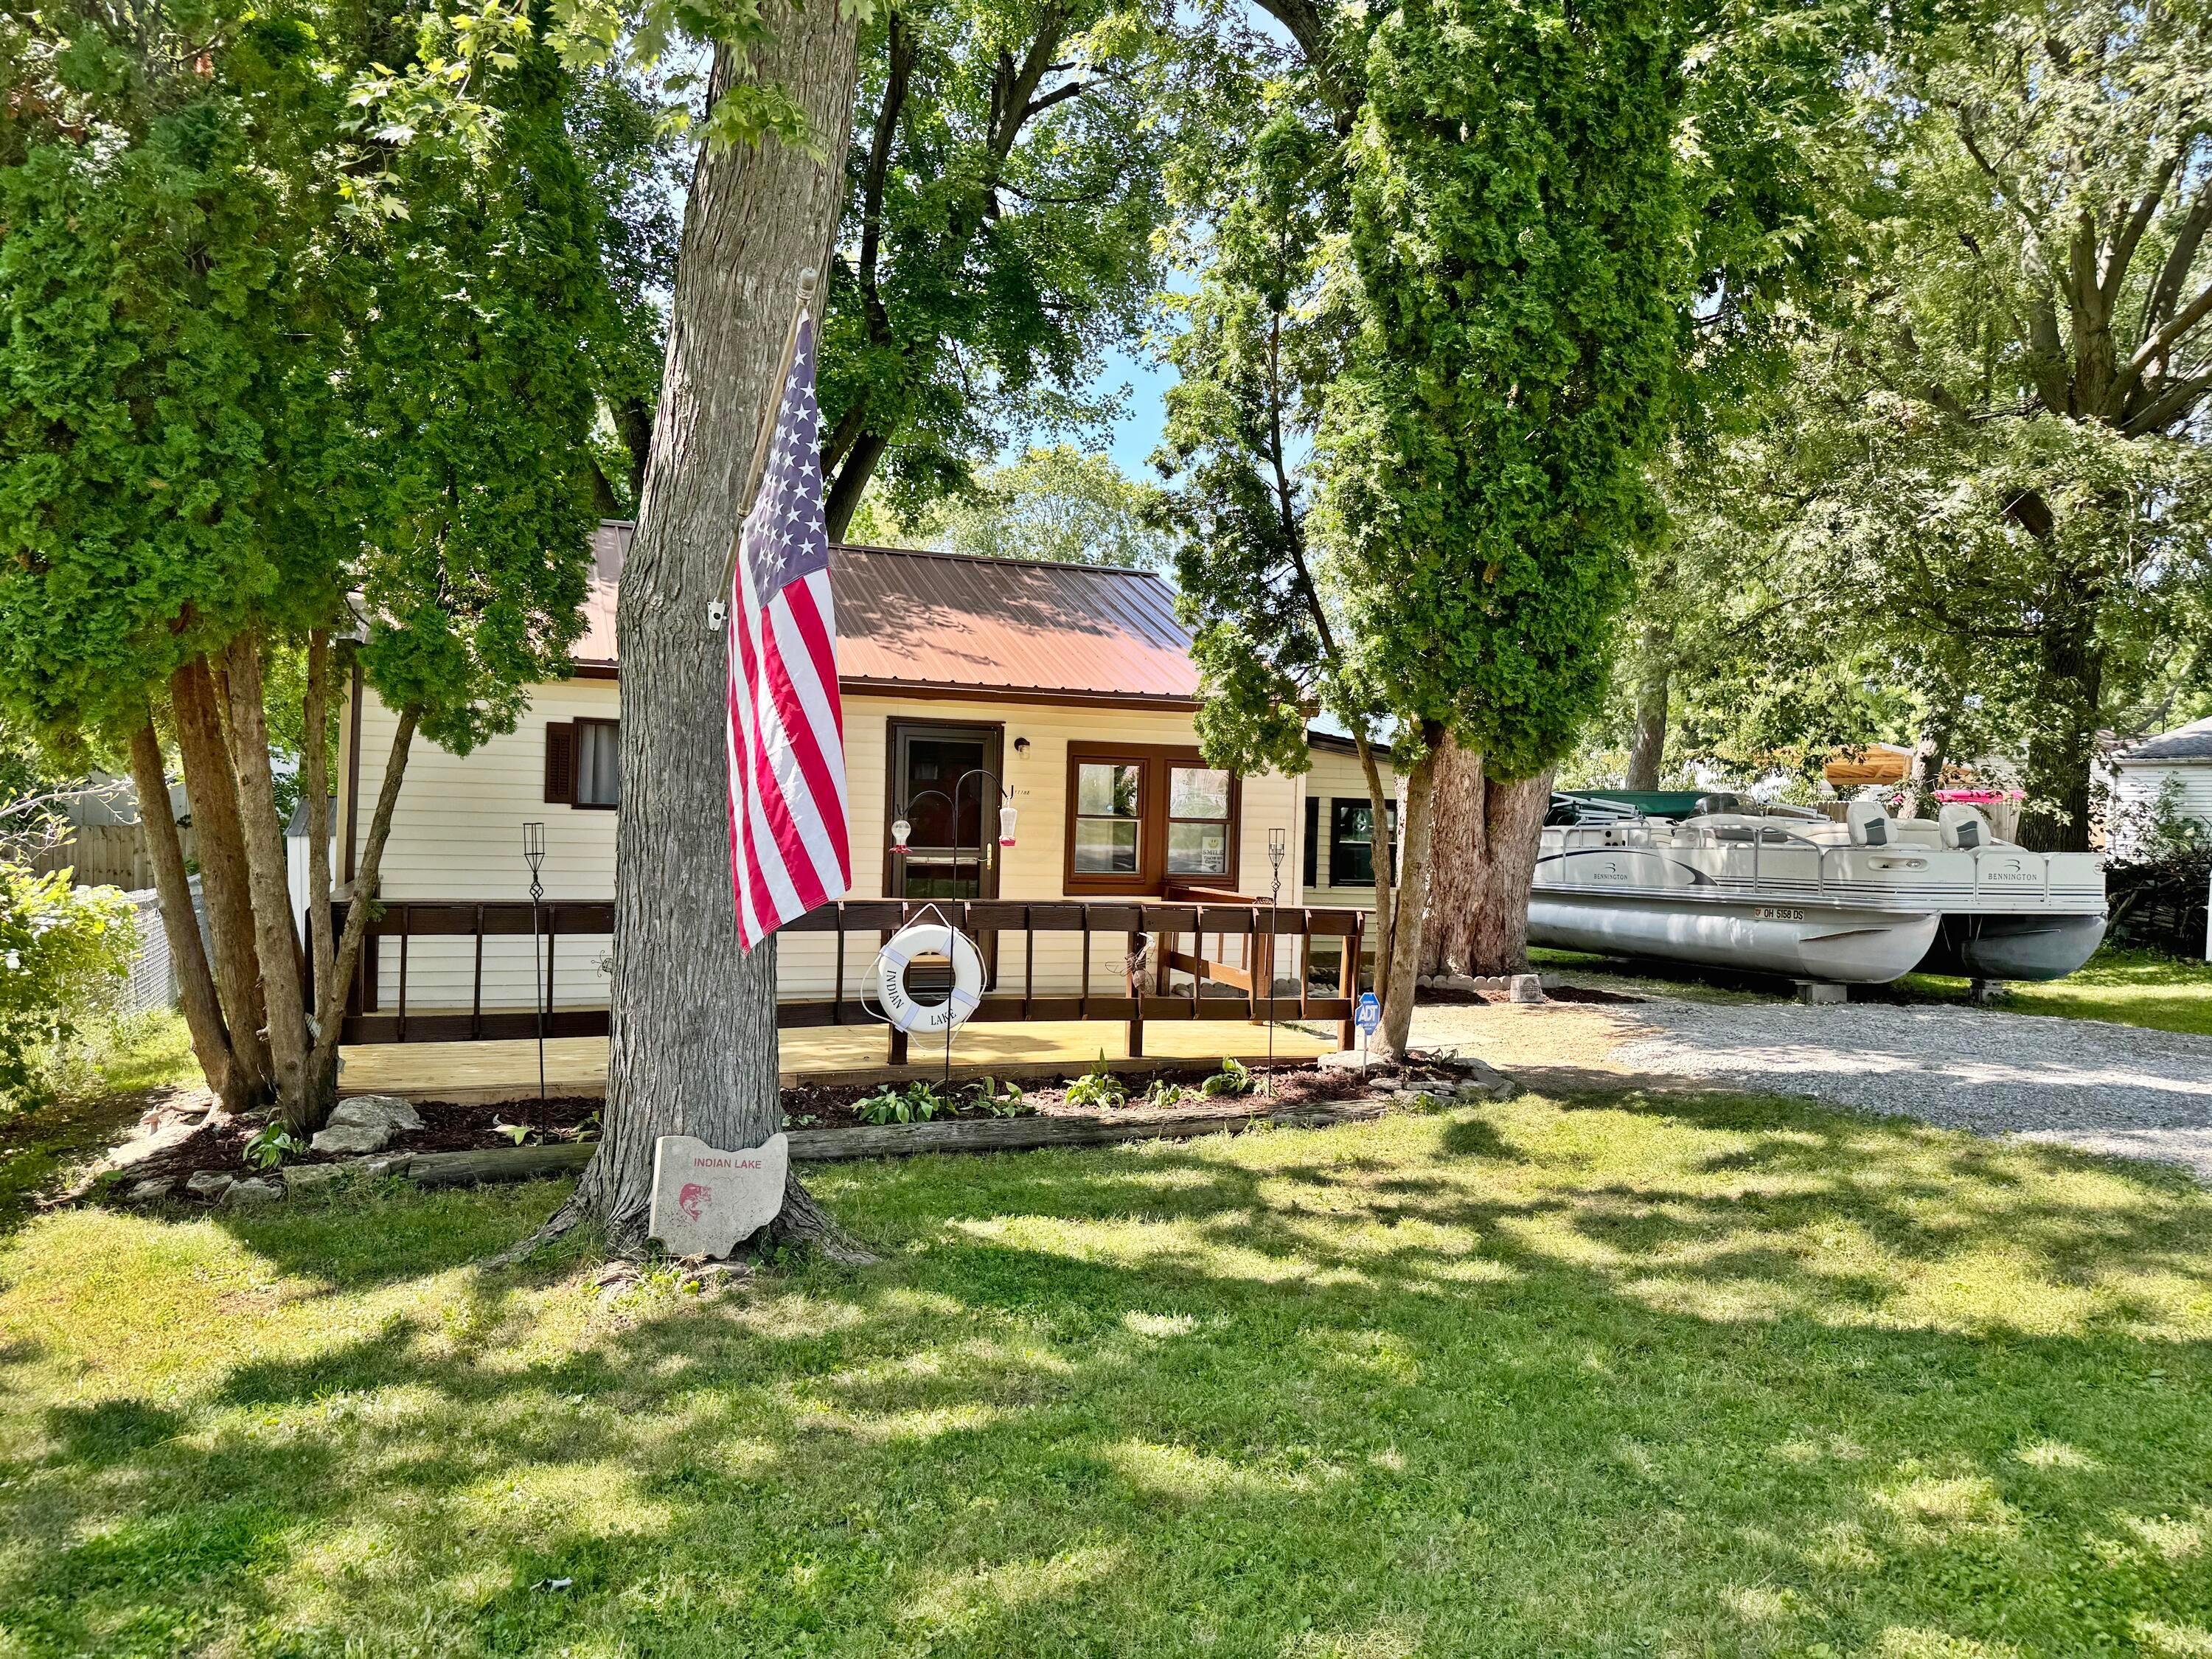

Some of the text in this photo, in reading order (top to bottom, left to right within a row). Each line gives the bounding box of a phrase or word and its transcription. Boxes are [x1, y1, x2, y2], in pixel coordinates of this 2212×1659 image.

[1764, 908, 1804, 920] OH 5158 DS
[886, 970, 957, 1026] INDIAN LAKE
[1357, 1004, 1379, 1022] ADT
[694, 1158, 762, 1169] INDIAN LAKE
